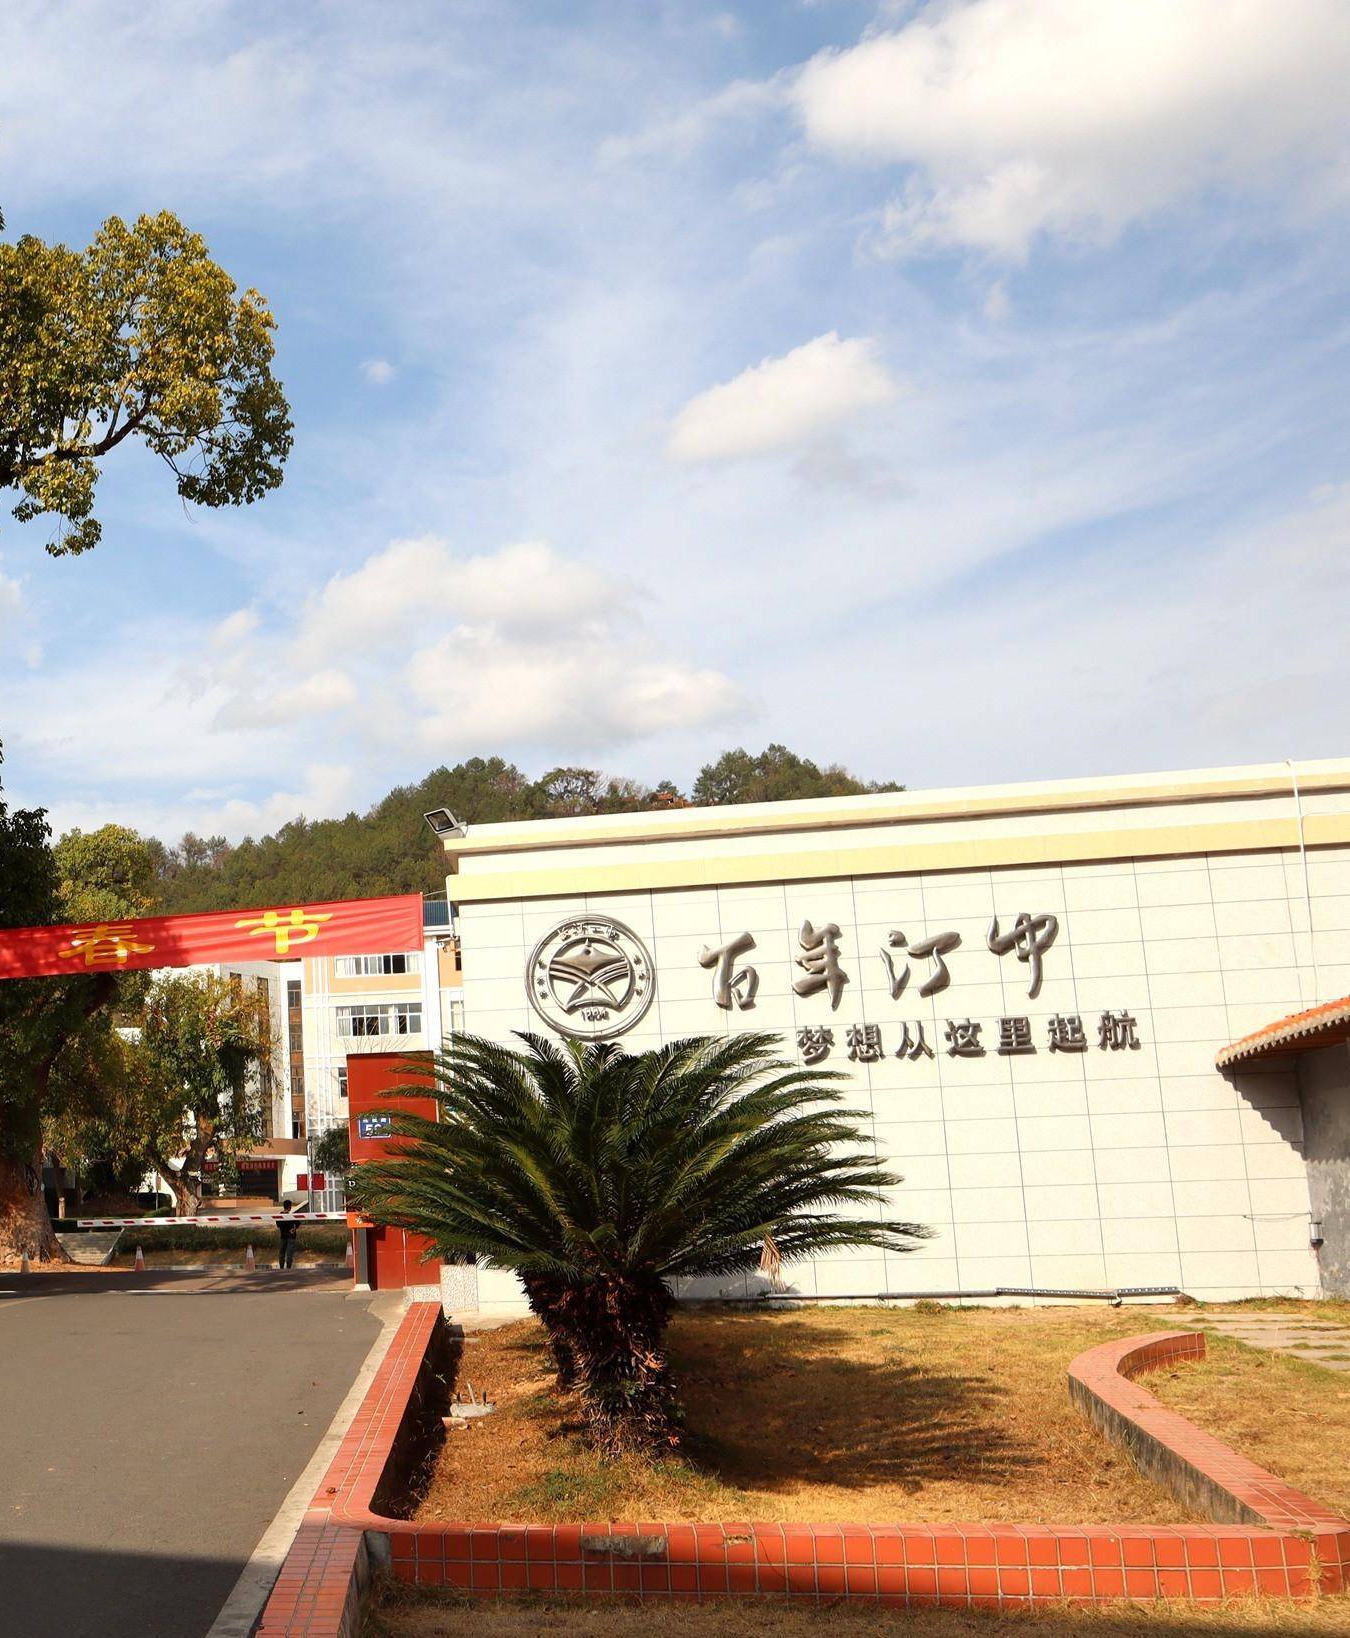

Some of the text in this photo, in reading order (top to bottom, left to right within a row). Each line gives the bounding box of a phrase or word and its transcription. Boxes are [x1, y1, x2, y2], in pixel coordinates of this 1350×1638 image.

[698, 912, 1059, 1011] 百年汀中
[796, 1009, 1141, 1066] 梦想从这里起航
